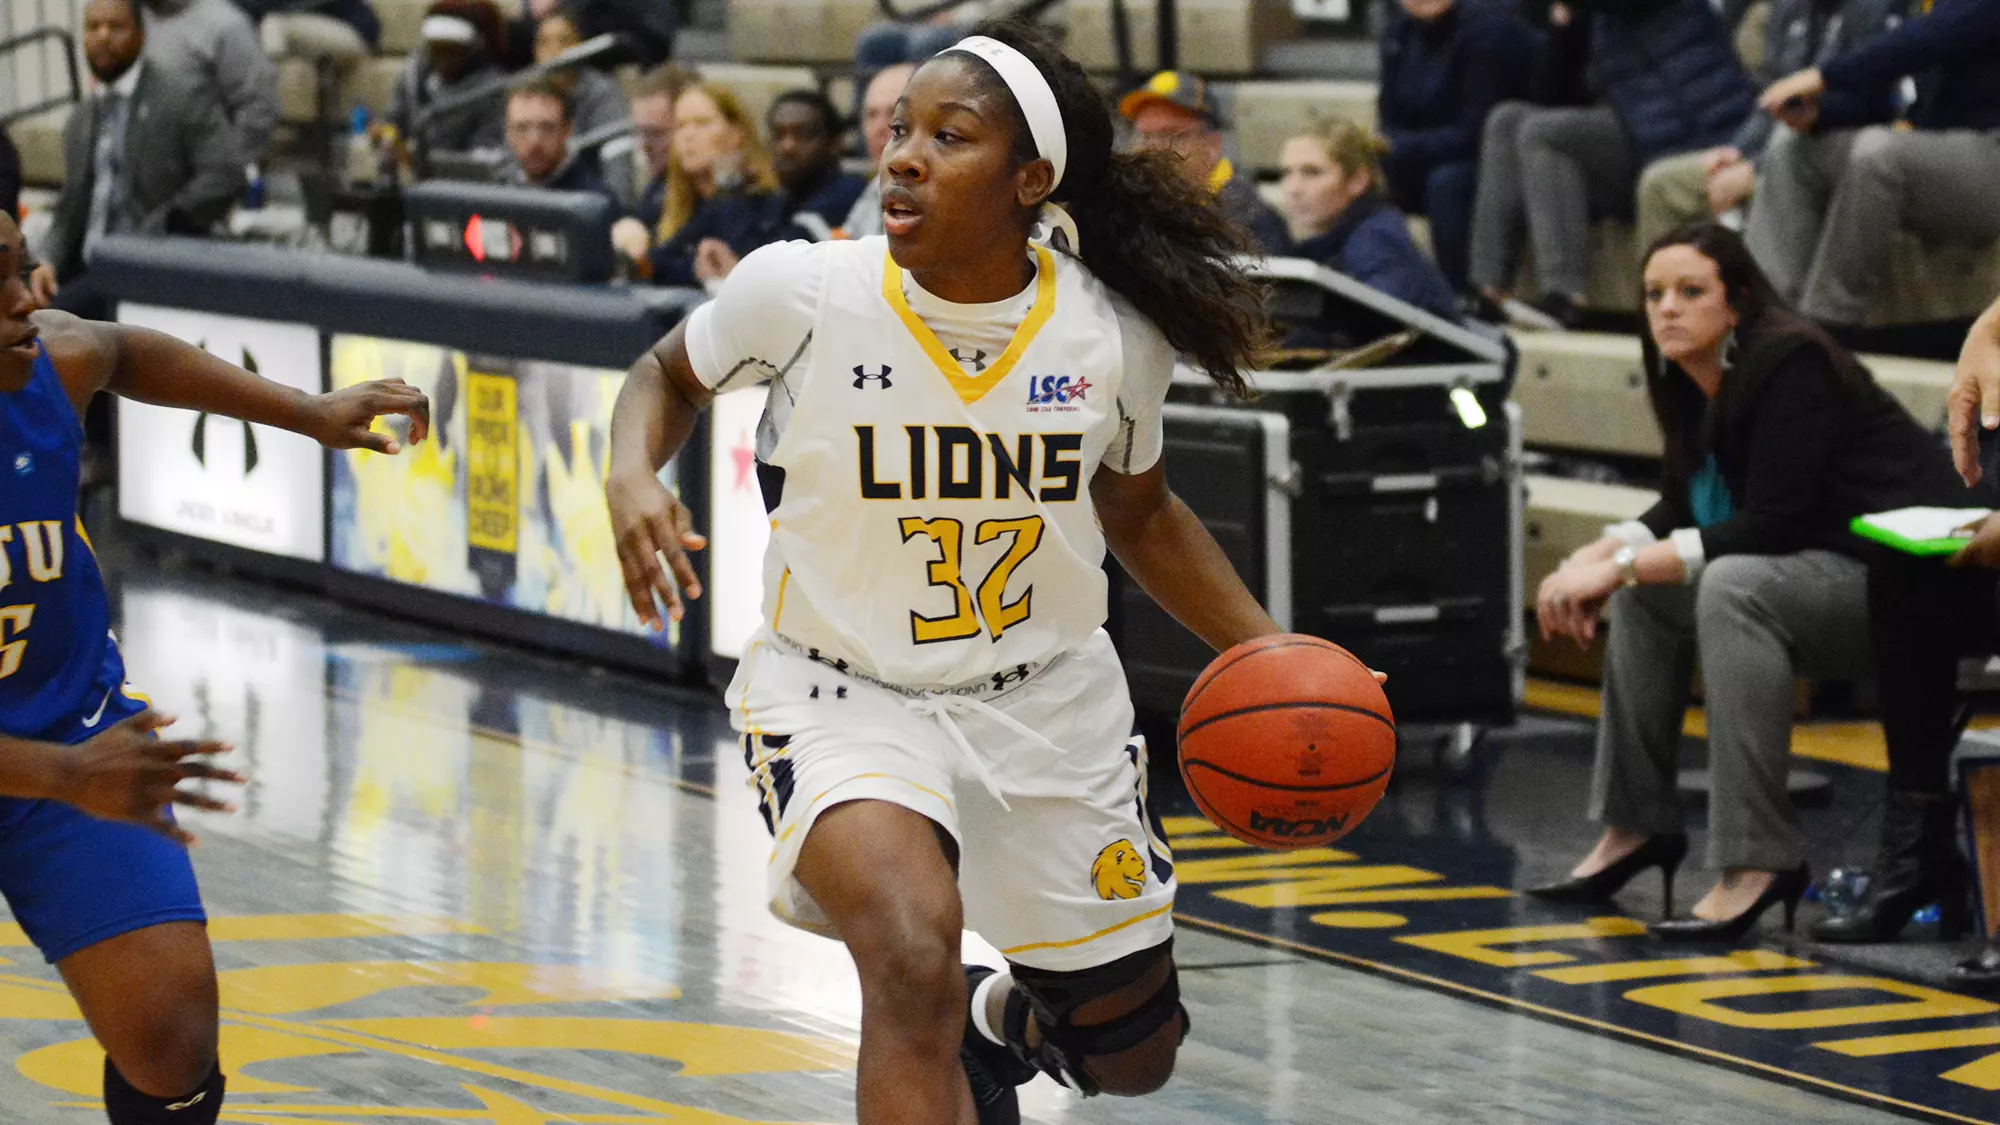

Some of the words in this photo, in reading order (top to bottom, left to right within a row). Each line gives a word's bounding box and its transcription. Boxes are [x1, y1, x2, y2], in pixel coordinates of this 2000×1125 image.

[1028, 375, 1070, 404] LSC
[852, 424, 1085, 504] LIONS
[897, 514, 1046, 646] 32
[1250, 809, 1350, 837] NCAA
